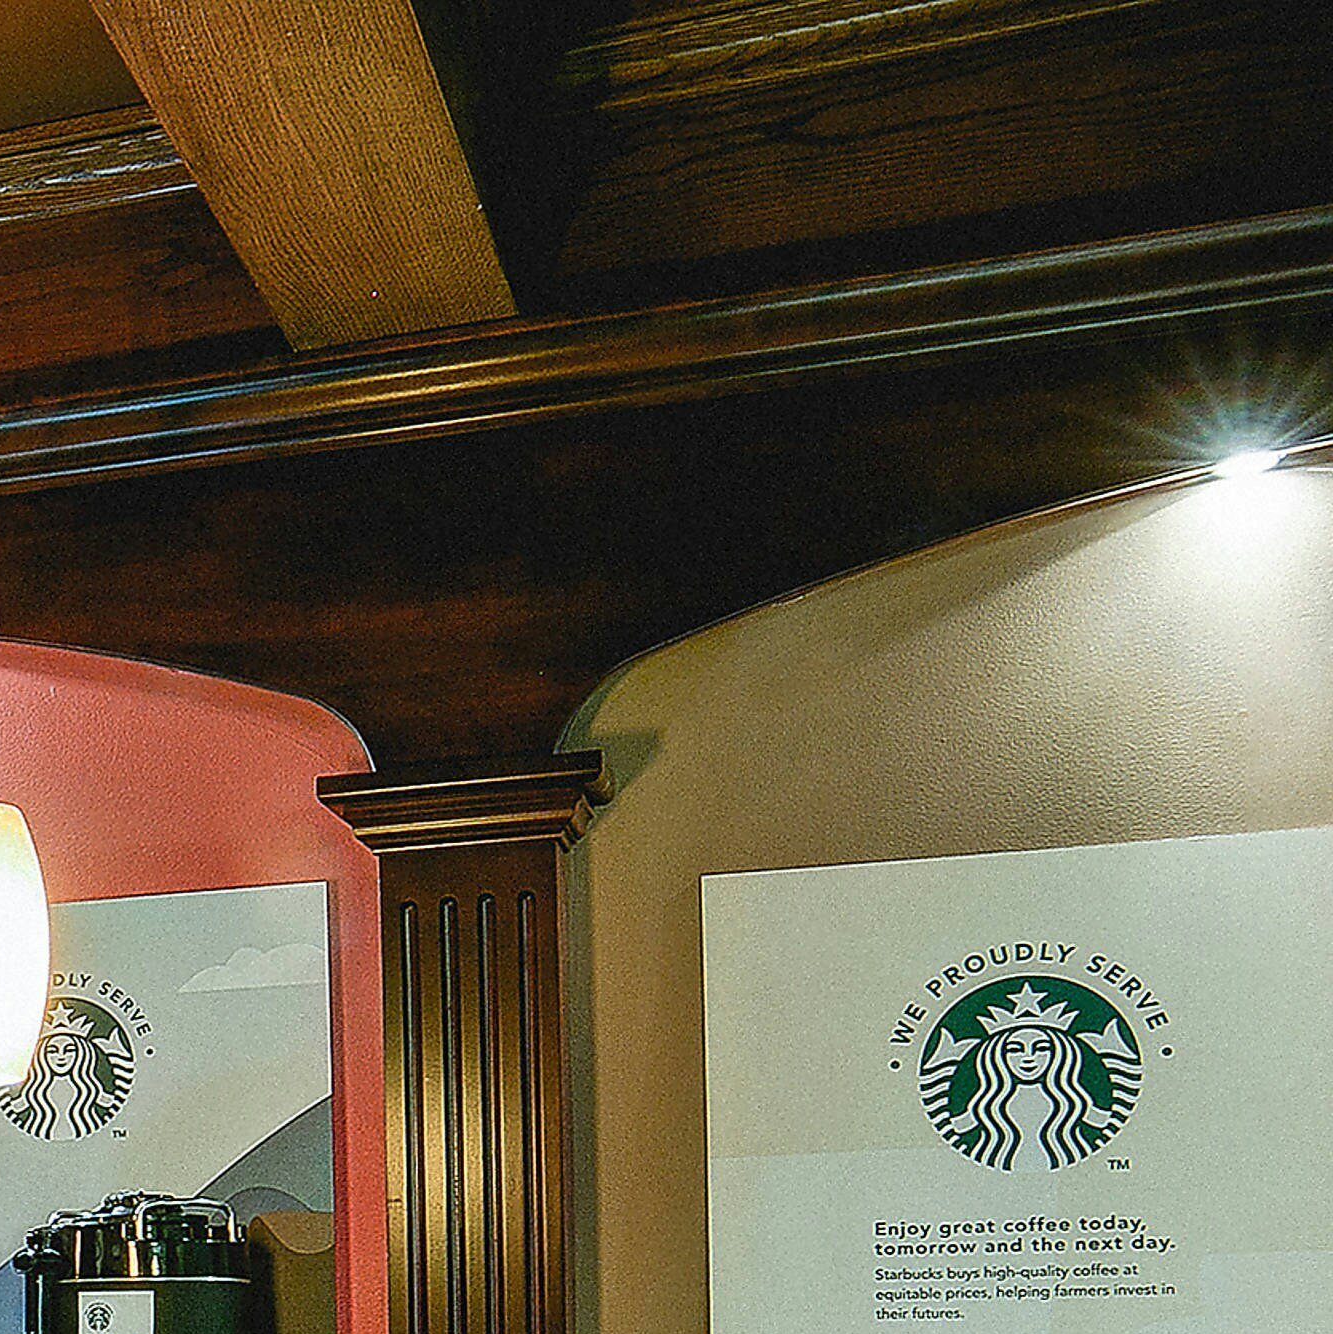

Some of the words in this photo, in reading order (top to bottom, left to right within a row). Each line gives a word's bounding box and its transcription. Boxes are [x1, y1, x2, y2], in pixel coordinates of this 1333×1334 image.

[890, 1002, 927, 1046] WE
[925, 942, 1076, 998] PROUDLY
[1085, 954, 1170, 1031] SERVE
[97, 981, 153, 1038] SERVE
[874, 1221, 931, 1239] Enjoy
[939, 1220, 995, 1238] great
[1003, 1217, 1071, 1233] coffee
[1078, 1215, 1147, 1233] today,
[874, 1241, 977, 1256] tomorrow
[984, 1238, 1023, 1253] and
[1032, 1237, 1066, 1252] the
[1075, 1236, 1124, 1251] next
[1131, 1234, 1176, 1252] day.
[874, 1267, 943, 1282] Starbucks
[946, 1267, 981, 1282] buys
[984, 1264, 1069, 1280] high-quality
[1073, 1264, 1119, 1277] coffee
[1123, 1264, 1139, 1276] at
[874, 1287, 942, 1302] equitable
[945, 1287, 993, 1302] prices,
[995, 1284, 1051, 1301] helping
[1054, 1284, 1111, 1298] farmers
[1113, 1283, 1158, 1296] invest
[1161, 1284, 1176, 1295] in
[876, 1306, 909, 1321] their
[911, 1306, 965, 1321] futures.
